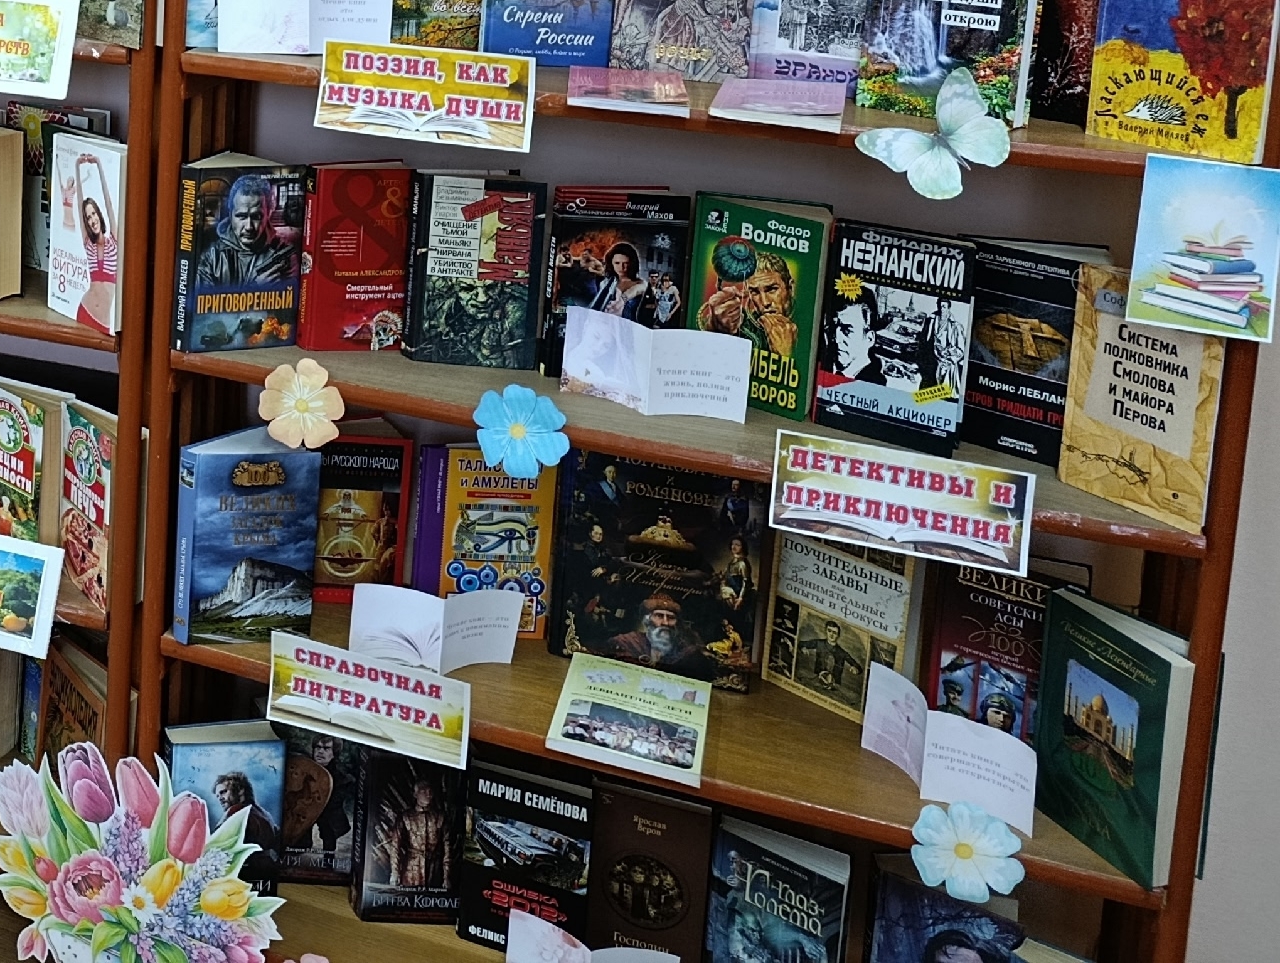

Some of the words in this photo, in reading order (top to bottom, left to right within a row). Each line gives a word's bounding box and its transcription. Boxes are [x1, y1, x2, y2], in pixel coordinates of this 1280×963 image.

[944, 12, 997, 28] открою
[536, 28, 594, 45] России
[343, 51, 445, 83] ПОЭЗИЯ,
[456, 62, 510, 85] КАК
[324, 85, 433, 112] МУЗЫКА
[445, 95, 523, 122] ДУШИ
[180, 179, 196, 252] ПРИГОВОРЕННЫЙ
[626, 202, 660, 212] Валерий
[646, 210, 674, 220] Махов
[434, 220, 477, 229] ОЧИЩЕНИЕ
[441, 227, 468, 236] ТЬМОЙ
[767, 220, 811, 238] Федор
[53, 247, 88, 267] ИДЕАЛЬНАЯ
[862, 231, 964, 260] ФРИДРИХ
[52, 257, 88, 283] ФИГУРА
[178, 258, 189, 294] ЕРЕМЕЕВ
[433, 259, 473, 269] УБИЙСТВО
[438, 268, 474, 277] АНТРАКТЕ
[840, 238, 965, 291] НЕЗНАНСКИЙ
[196, 285, 294, 314] ПРИГОВОРЕННЫЙ
[346, 284, 393, 292] Смертельный
[176, 295, 188, 332] ВАЛЕРИЙ
[750, 382, 796, 410] ВОРОВ
[978, 375, 1015, 394] Морис
[826, 389, 879, 411] ЧЕСТНЫЙ
[887, 402, 952, 428] АКЦИОНЕР
[997, 396, 1044, 421] ТРИДЦАТИ
[331, 455, 368, 468] РУССКОГО
[369, 457, 399, 470] НАРОДА
[472, 476, 538, 490] АМУЛЕТЫ
[790, 446, 976, 500] ДЕТЕКТИВЫ
[992, 481, 1016, 507] И
[783, 483, 1014, 546] ПРИКЛЮЧЕНИЯ
[783, 537, 903, 594] ПОУЧИТЕЛЬНЫЕ
[812, 564, 868, 595] ЗАБАВЫ
[995, 613, 1024, 628] АСЫ
[295, 646, 443, 700] СПРАВОЧНАЯ
[292, 676, 443, 732] ЛИТЕРАТУРА
[478, 779, 522, 802] МАРИЯ
[524, 793, 588, 822] СЕМЁНОВА
[492, 880, 559, 907] ОШИБКА
